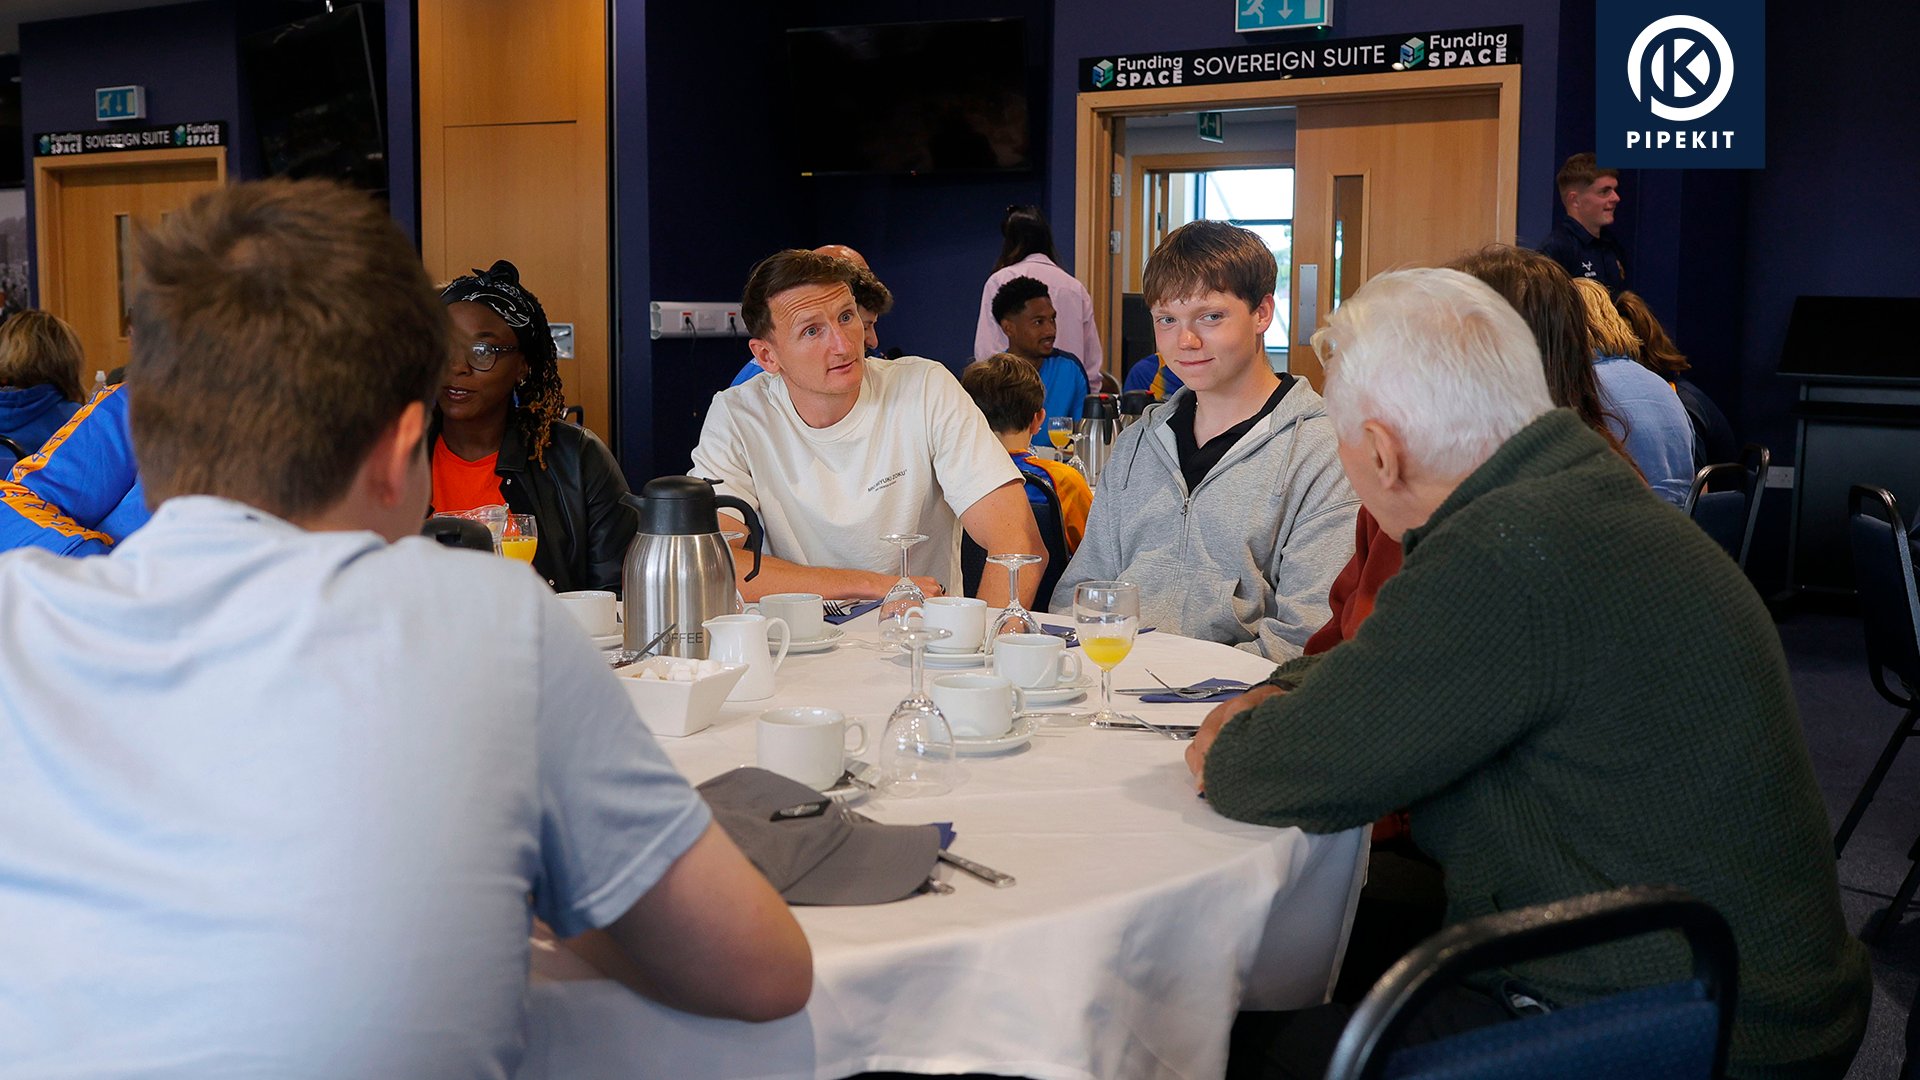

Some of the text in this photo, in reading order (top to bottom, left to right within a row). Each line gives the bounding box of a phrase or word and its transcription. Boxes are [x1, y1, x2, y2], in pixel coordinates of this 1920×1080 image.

[1430, 32, 1508, 49] Funding
[1117, 55, 1183, 70] Funding
[1193, 45, 1385, 76] SOVEREIGN SUITE
[1428, 48, 1507, 67] SPACE
[1116, 70, 1183, 87] SPACE
[186, 124, 220, 135] Funding
[51, 133, 82, 143] Funding
[85, 130, 170, 149] SOVEREIGN SUITE
[186, 133, 220, 146] SPACE
[51, 142, 82, 154] SPACE
